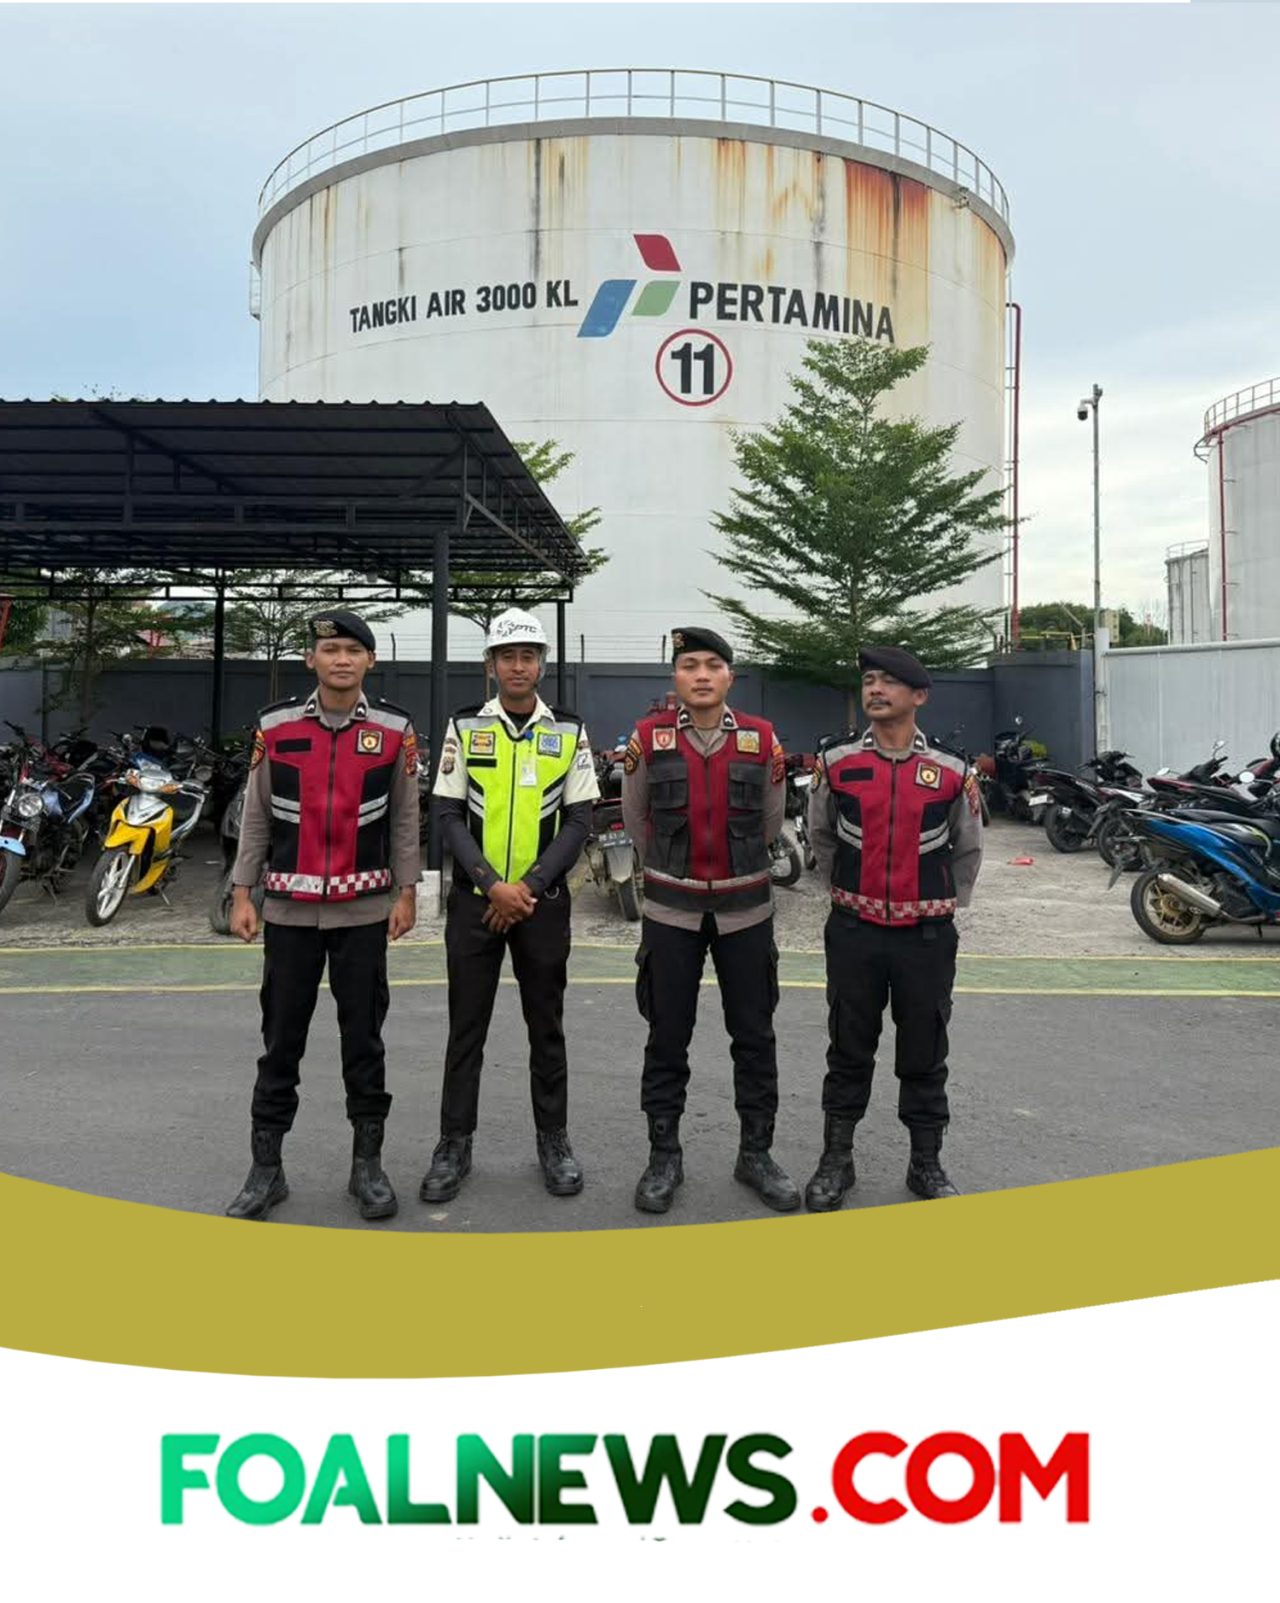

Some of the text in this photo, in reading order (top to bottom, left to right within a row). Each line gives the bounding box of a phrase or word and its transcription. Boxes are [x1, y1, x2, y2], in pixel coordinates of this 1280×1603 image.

[350, 279, 579, 332] TANGKI AIR 3000 KL
[689, 281, 895, 343] PERTAMINA
[670, 341, 715, 395] 11
